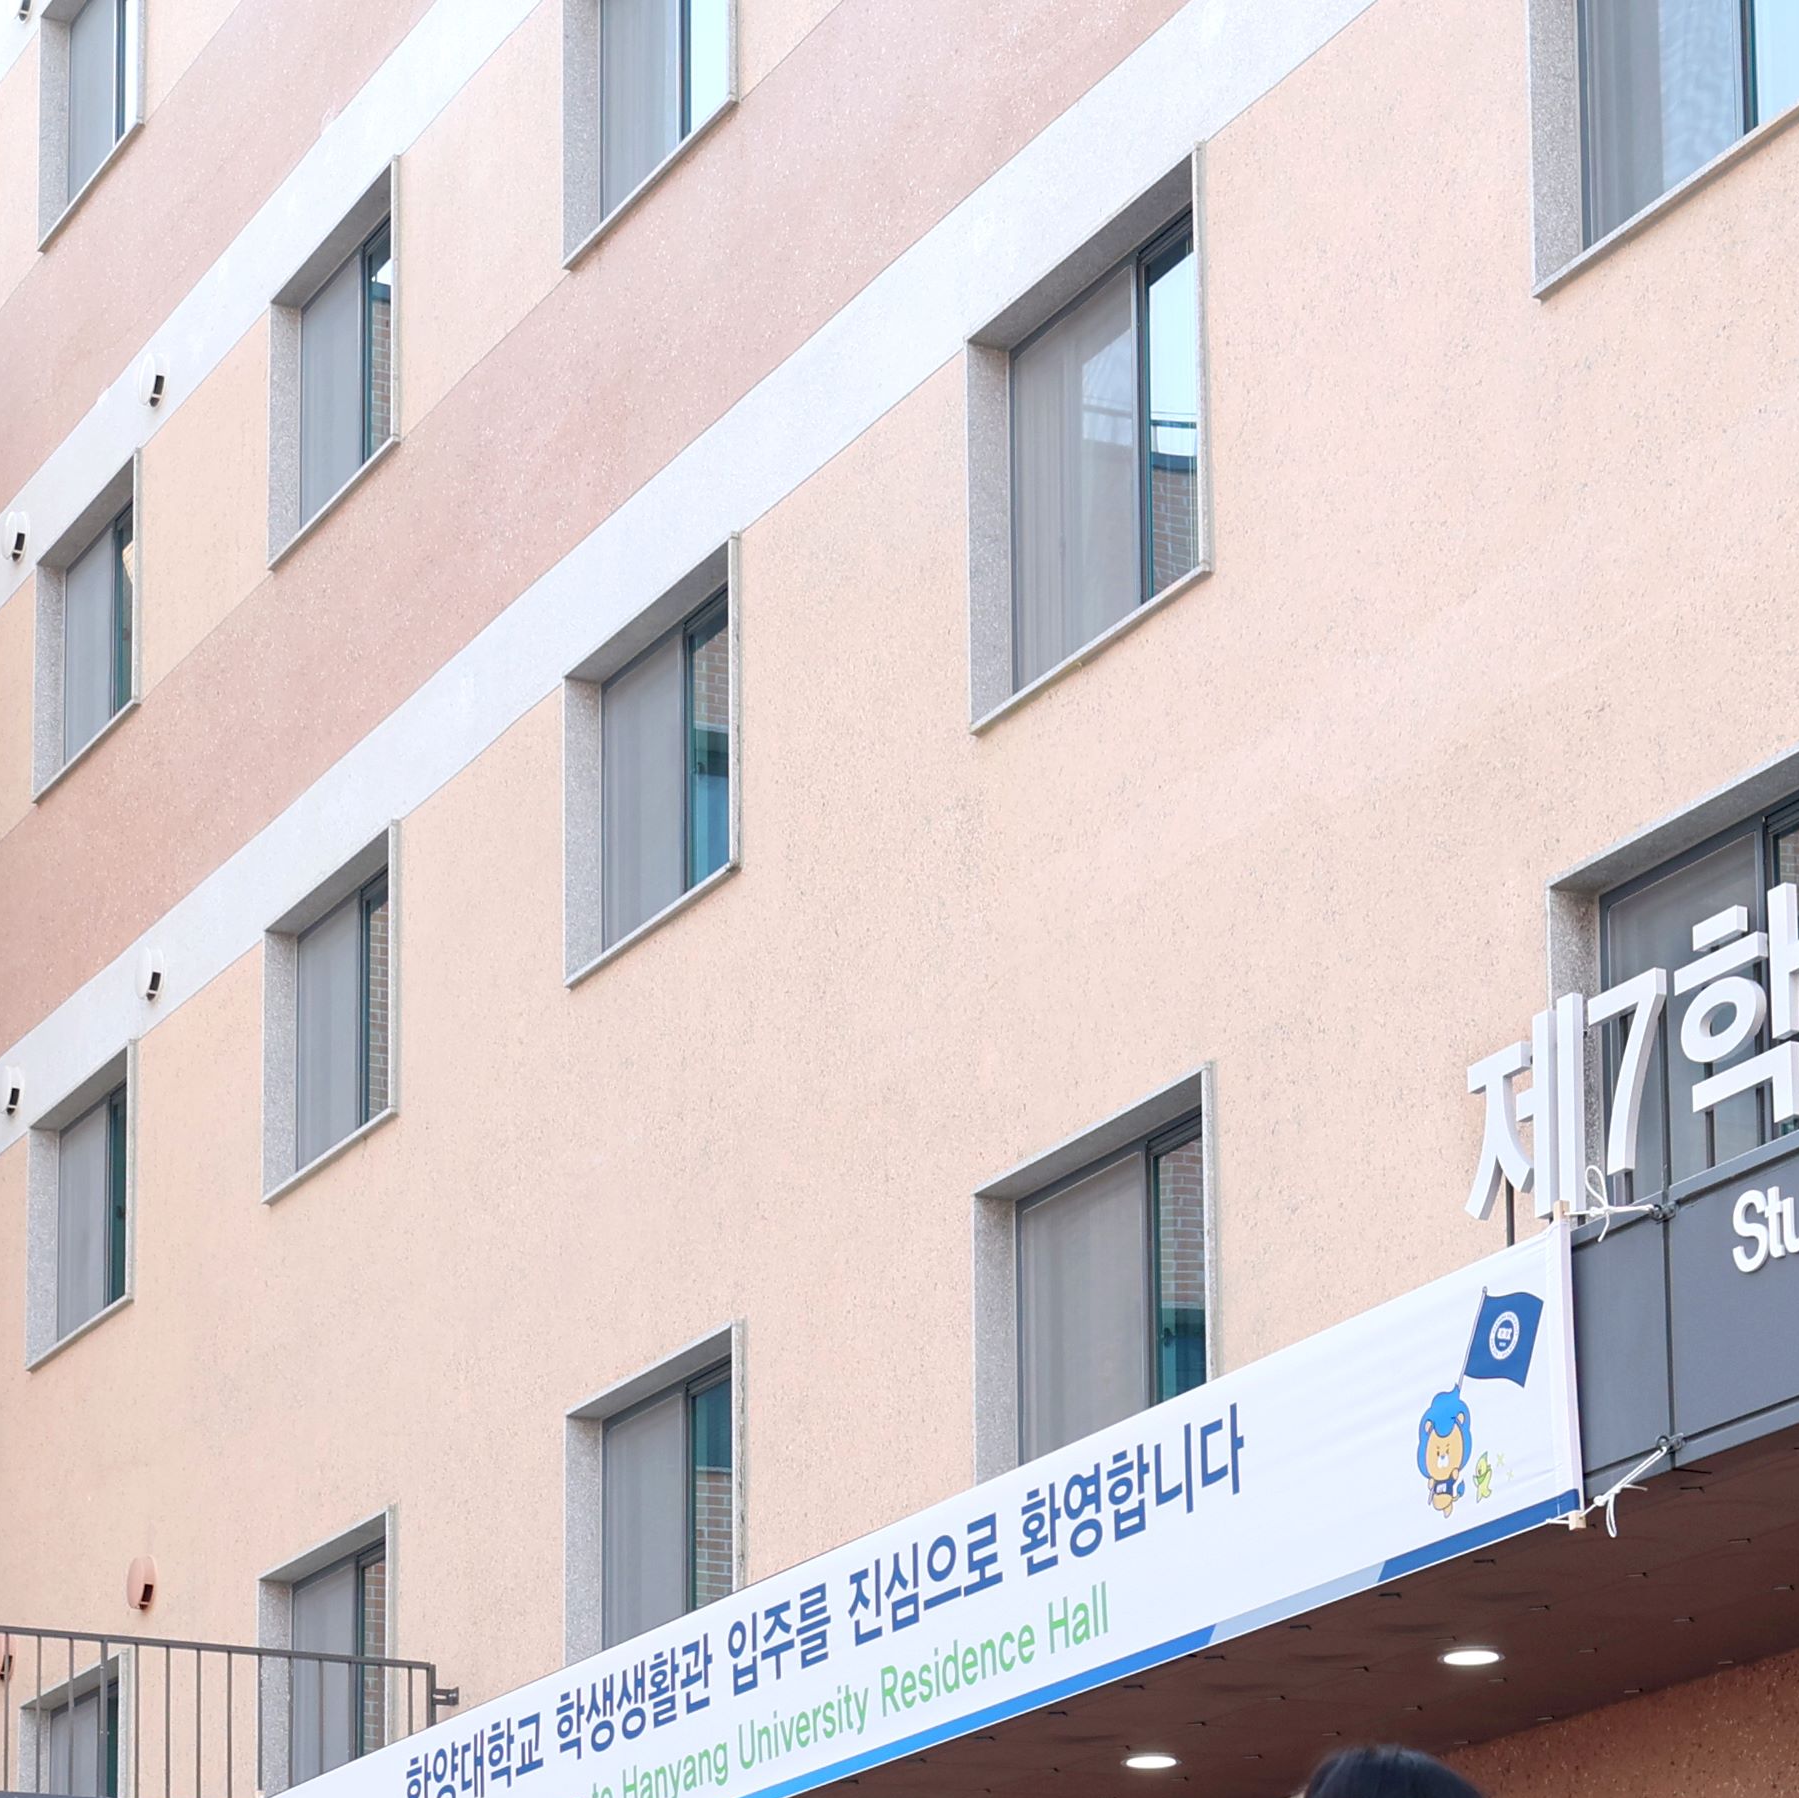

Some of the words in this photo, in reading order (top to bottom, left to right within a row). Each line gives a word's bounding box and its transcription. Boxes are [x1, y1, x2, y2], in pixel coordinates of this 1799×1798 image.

[556, 1632, 712, 1760] 학생생활관
[728, 1583, 832, 1696] 입주를
[848, 1513, 1004, 1648] 진심으로
[1020, 1402, 1245, 1576] 환영합니다
[738, 1685, 870, 1770] University
[880, 1623, 1037, 1715] Residence
[1048, 1581, 1110, 1654] Hall
